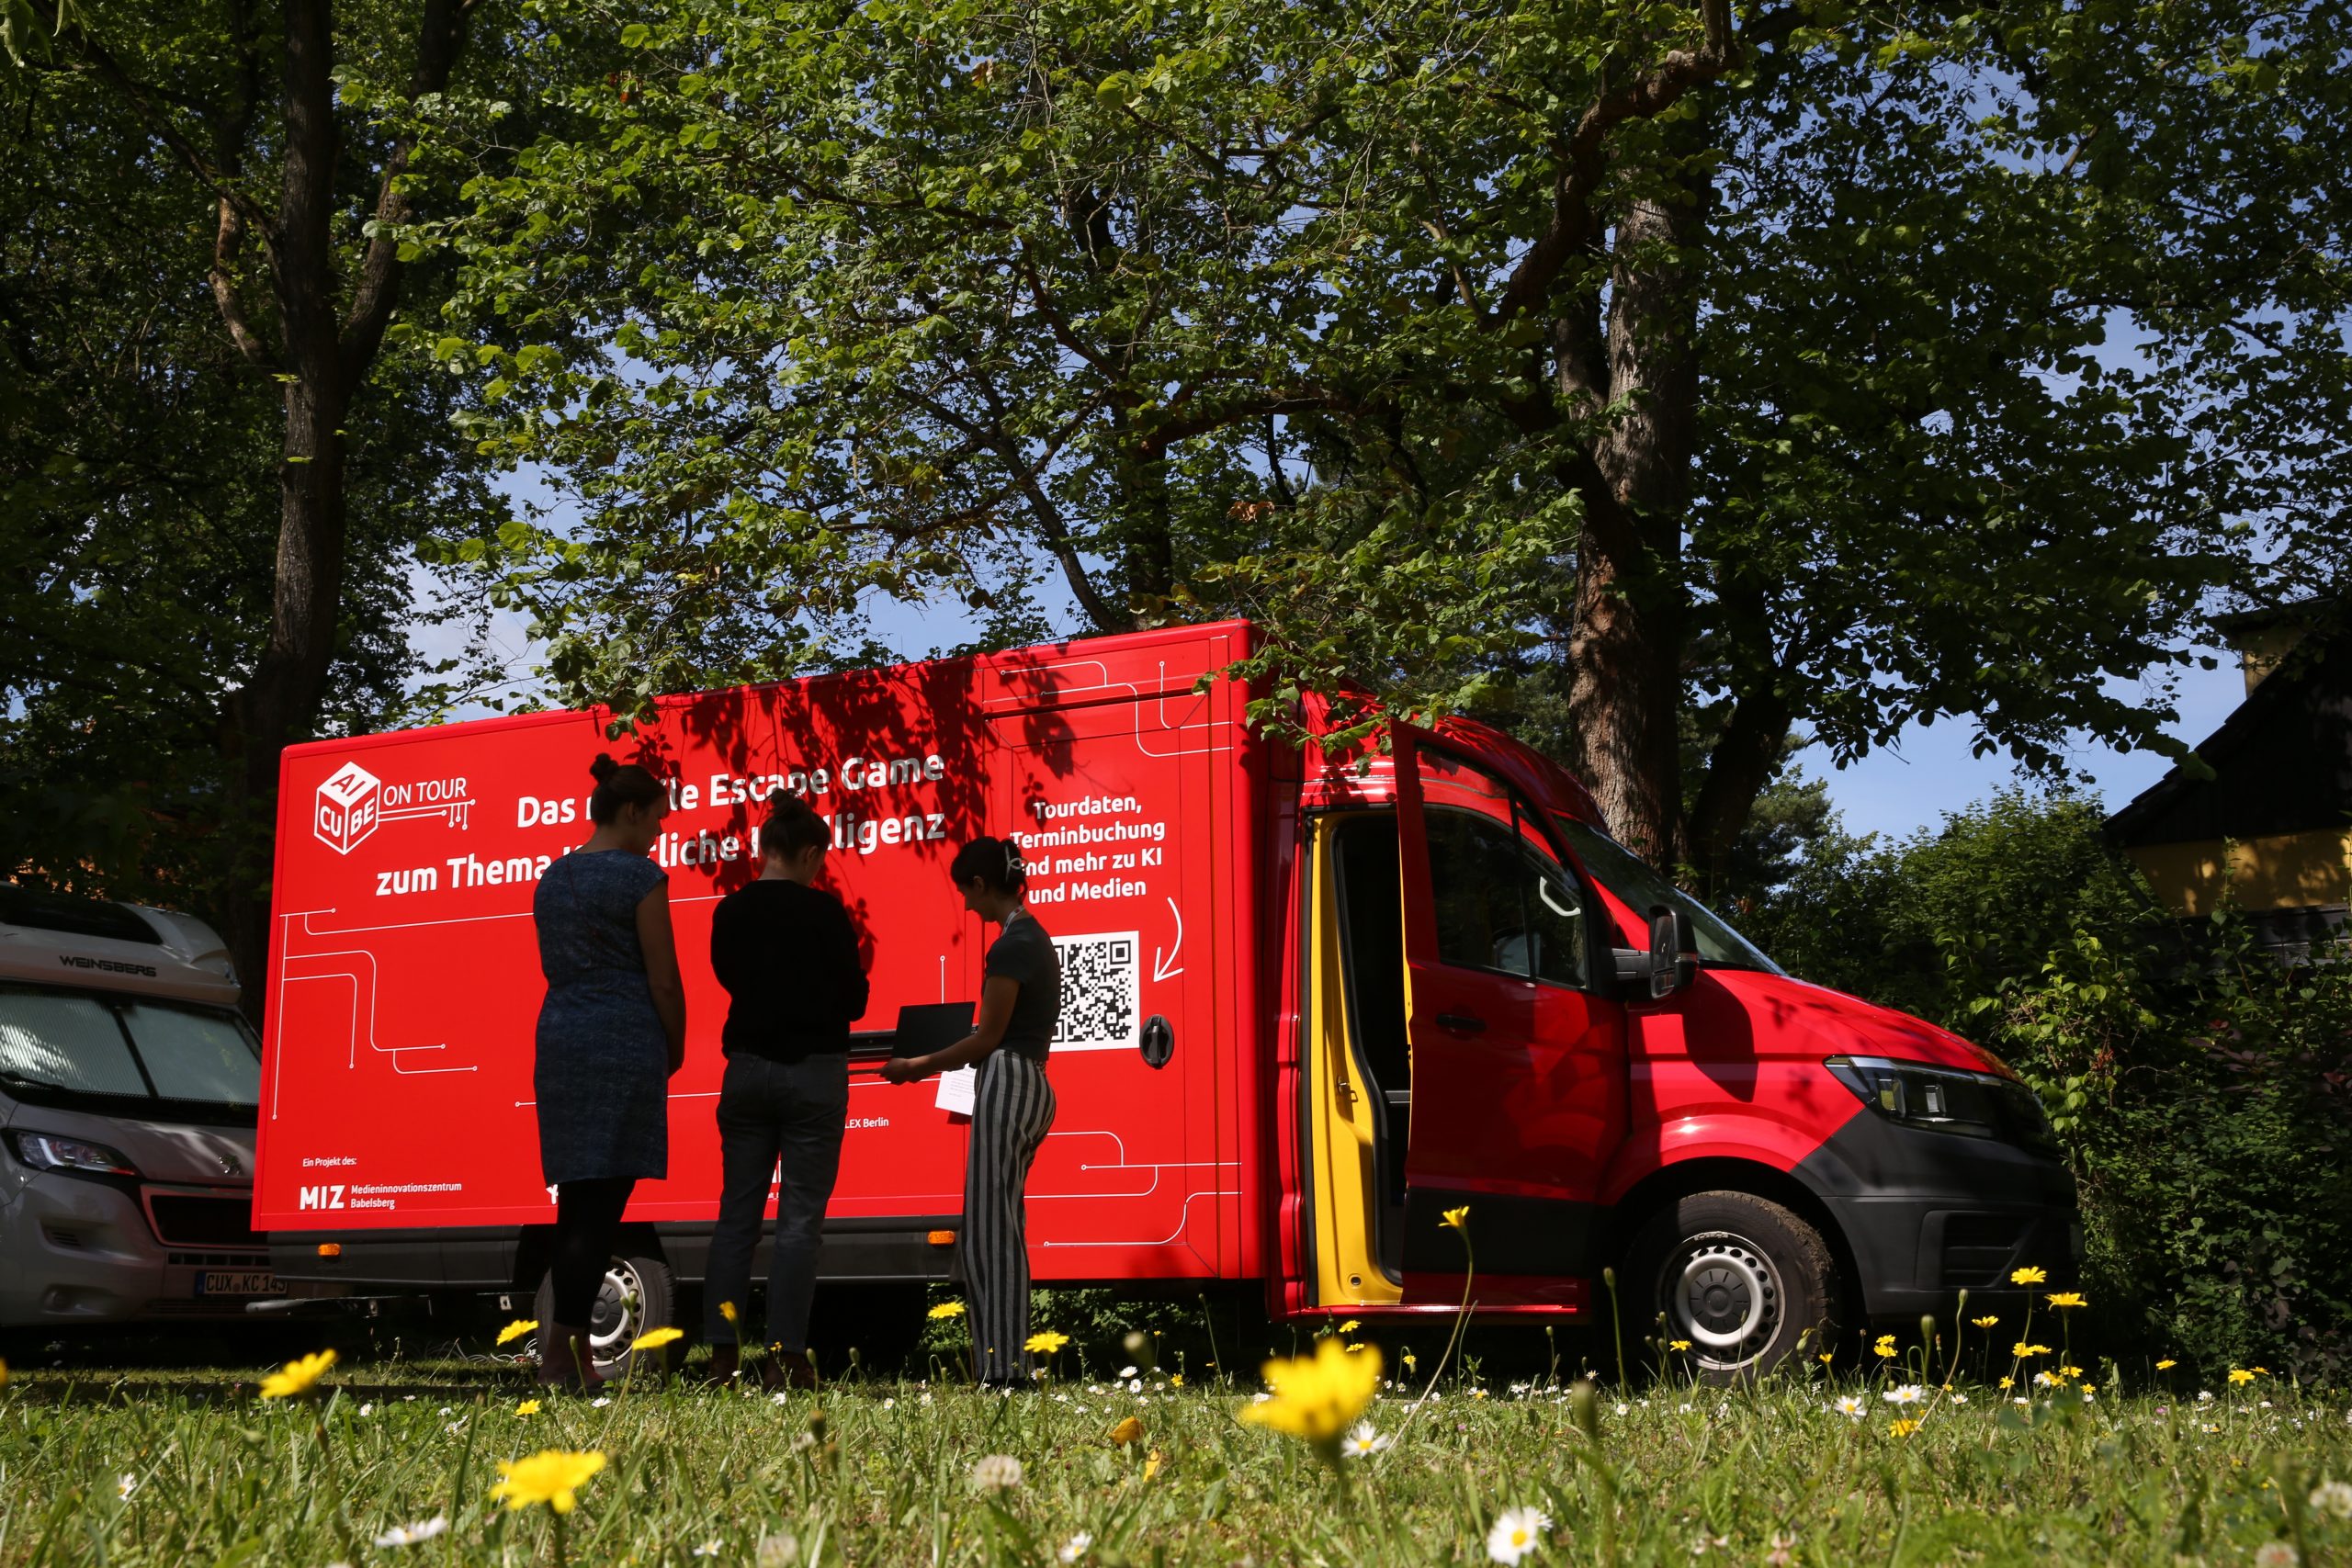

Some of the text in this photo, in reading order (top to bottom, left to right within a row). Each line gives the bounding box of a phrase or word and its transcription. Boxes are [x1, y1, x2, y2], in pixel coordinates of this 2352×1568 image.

[331, 773, 366, 796] AI
[383, 777, 467, 807] ON TOUR
[516, 795, 576, 828] Das
[710, 767, 830, 807] Escape
[841, 754, 944, 791] Game
[1033, 795, 1142, 819] Tourdaten,
[1010, 820, 1165, 849] Terminbuchung
[376, 867, 437, 896] zum
[447, 852, 551, 888] Thema
[1022, 847, 1162, 876] nd mehr zu KI
[1028, 877, 1147, 904] und Medien
[59, 954, 157, 978] WEINSBERG
[863, 1117, 889, 1128] Berlin
[302, 1156, 357, 1168] Ein Projekt des:
[300, 1182, 462, 1210] MIZ Medieninnovationszentrum
[350, 1197, 395, 1210] Babelsberg
[206, 1274, 232, 1292] CUX
[243, 1274, 259, 1292] KC
